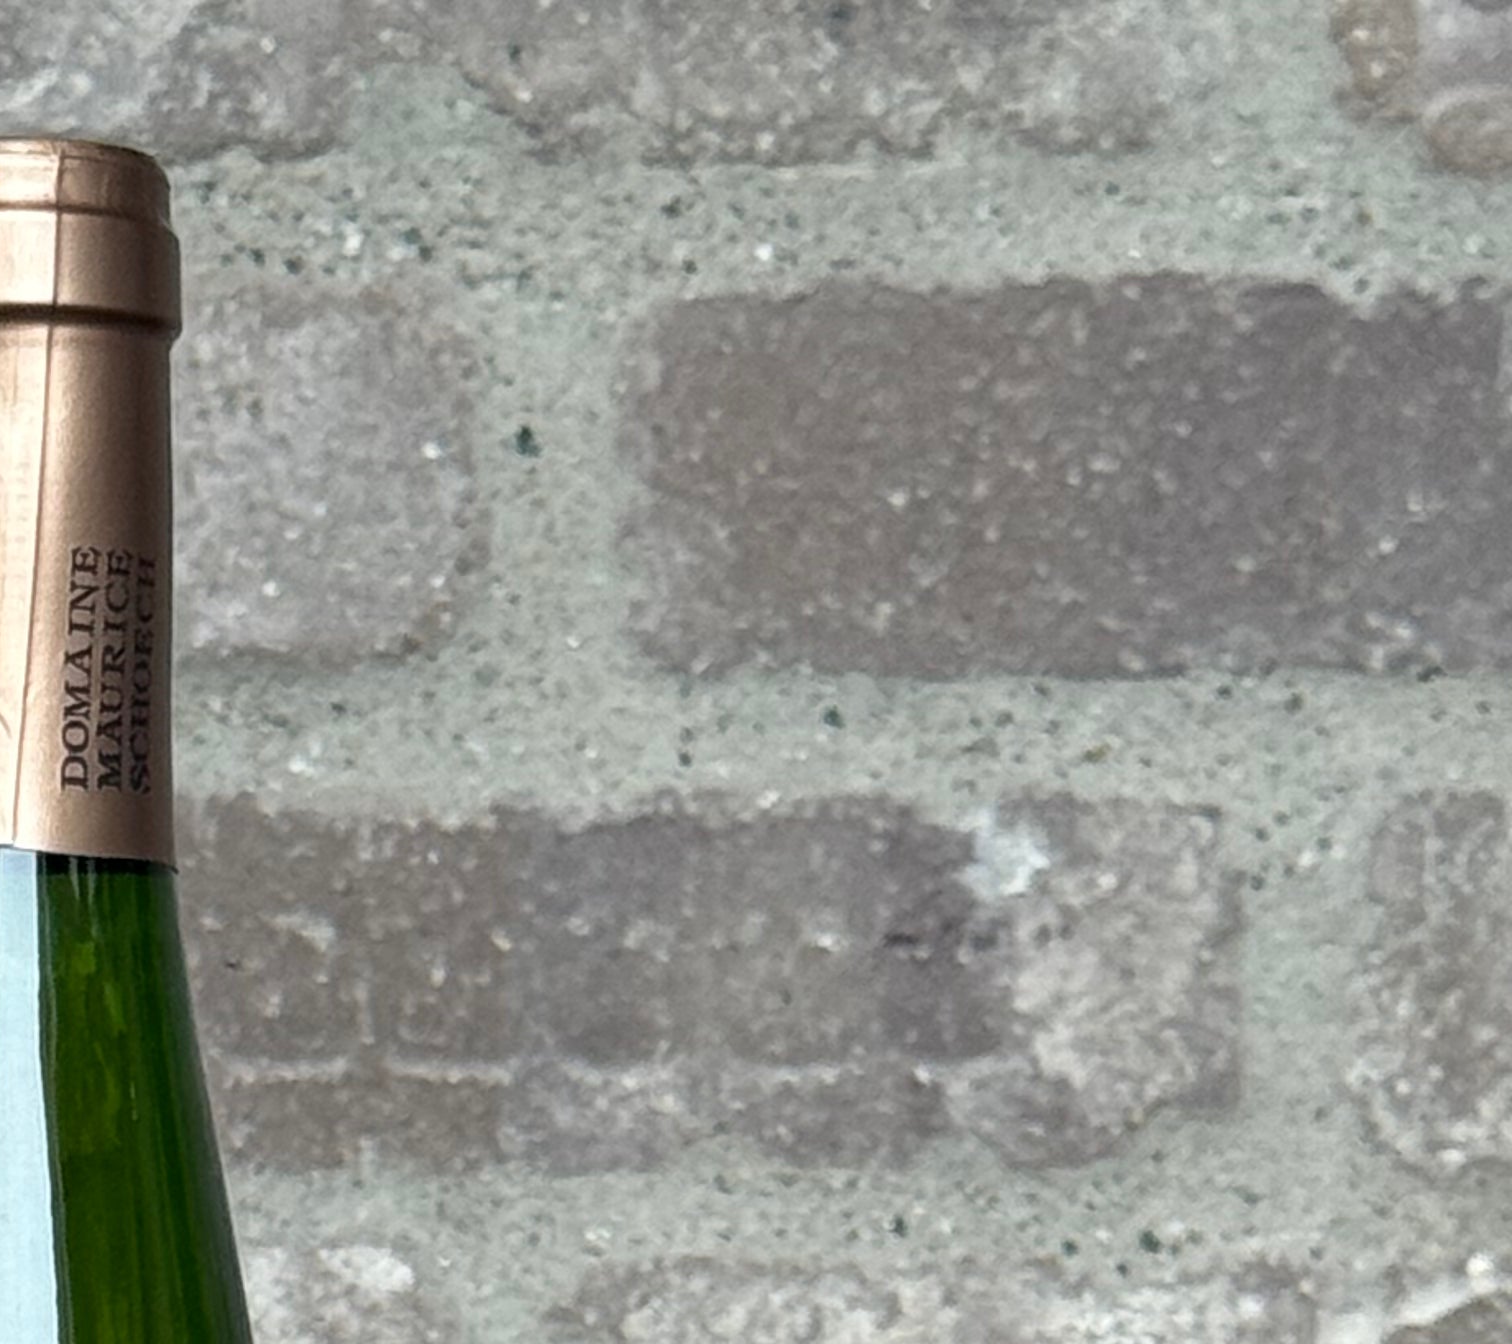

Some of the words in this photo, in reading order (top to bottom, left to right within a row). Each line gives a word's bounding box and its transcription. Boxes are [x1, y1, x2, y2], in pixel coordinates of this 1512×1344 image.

[61, 545, 101, 792] DOMAINE
[97, 549, 134, 793] MAURICE
[128, 556, 156, 795] SCHOECH
